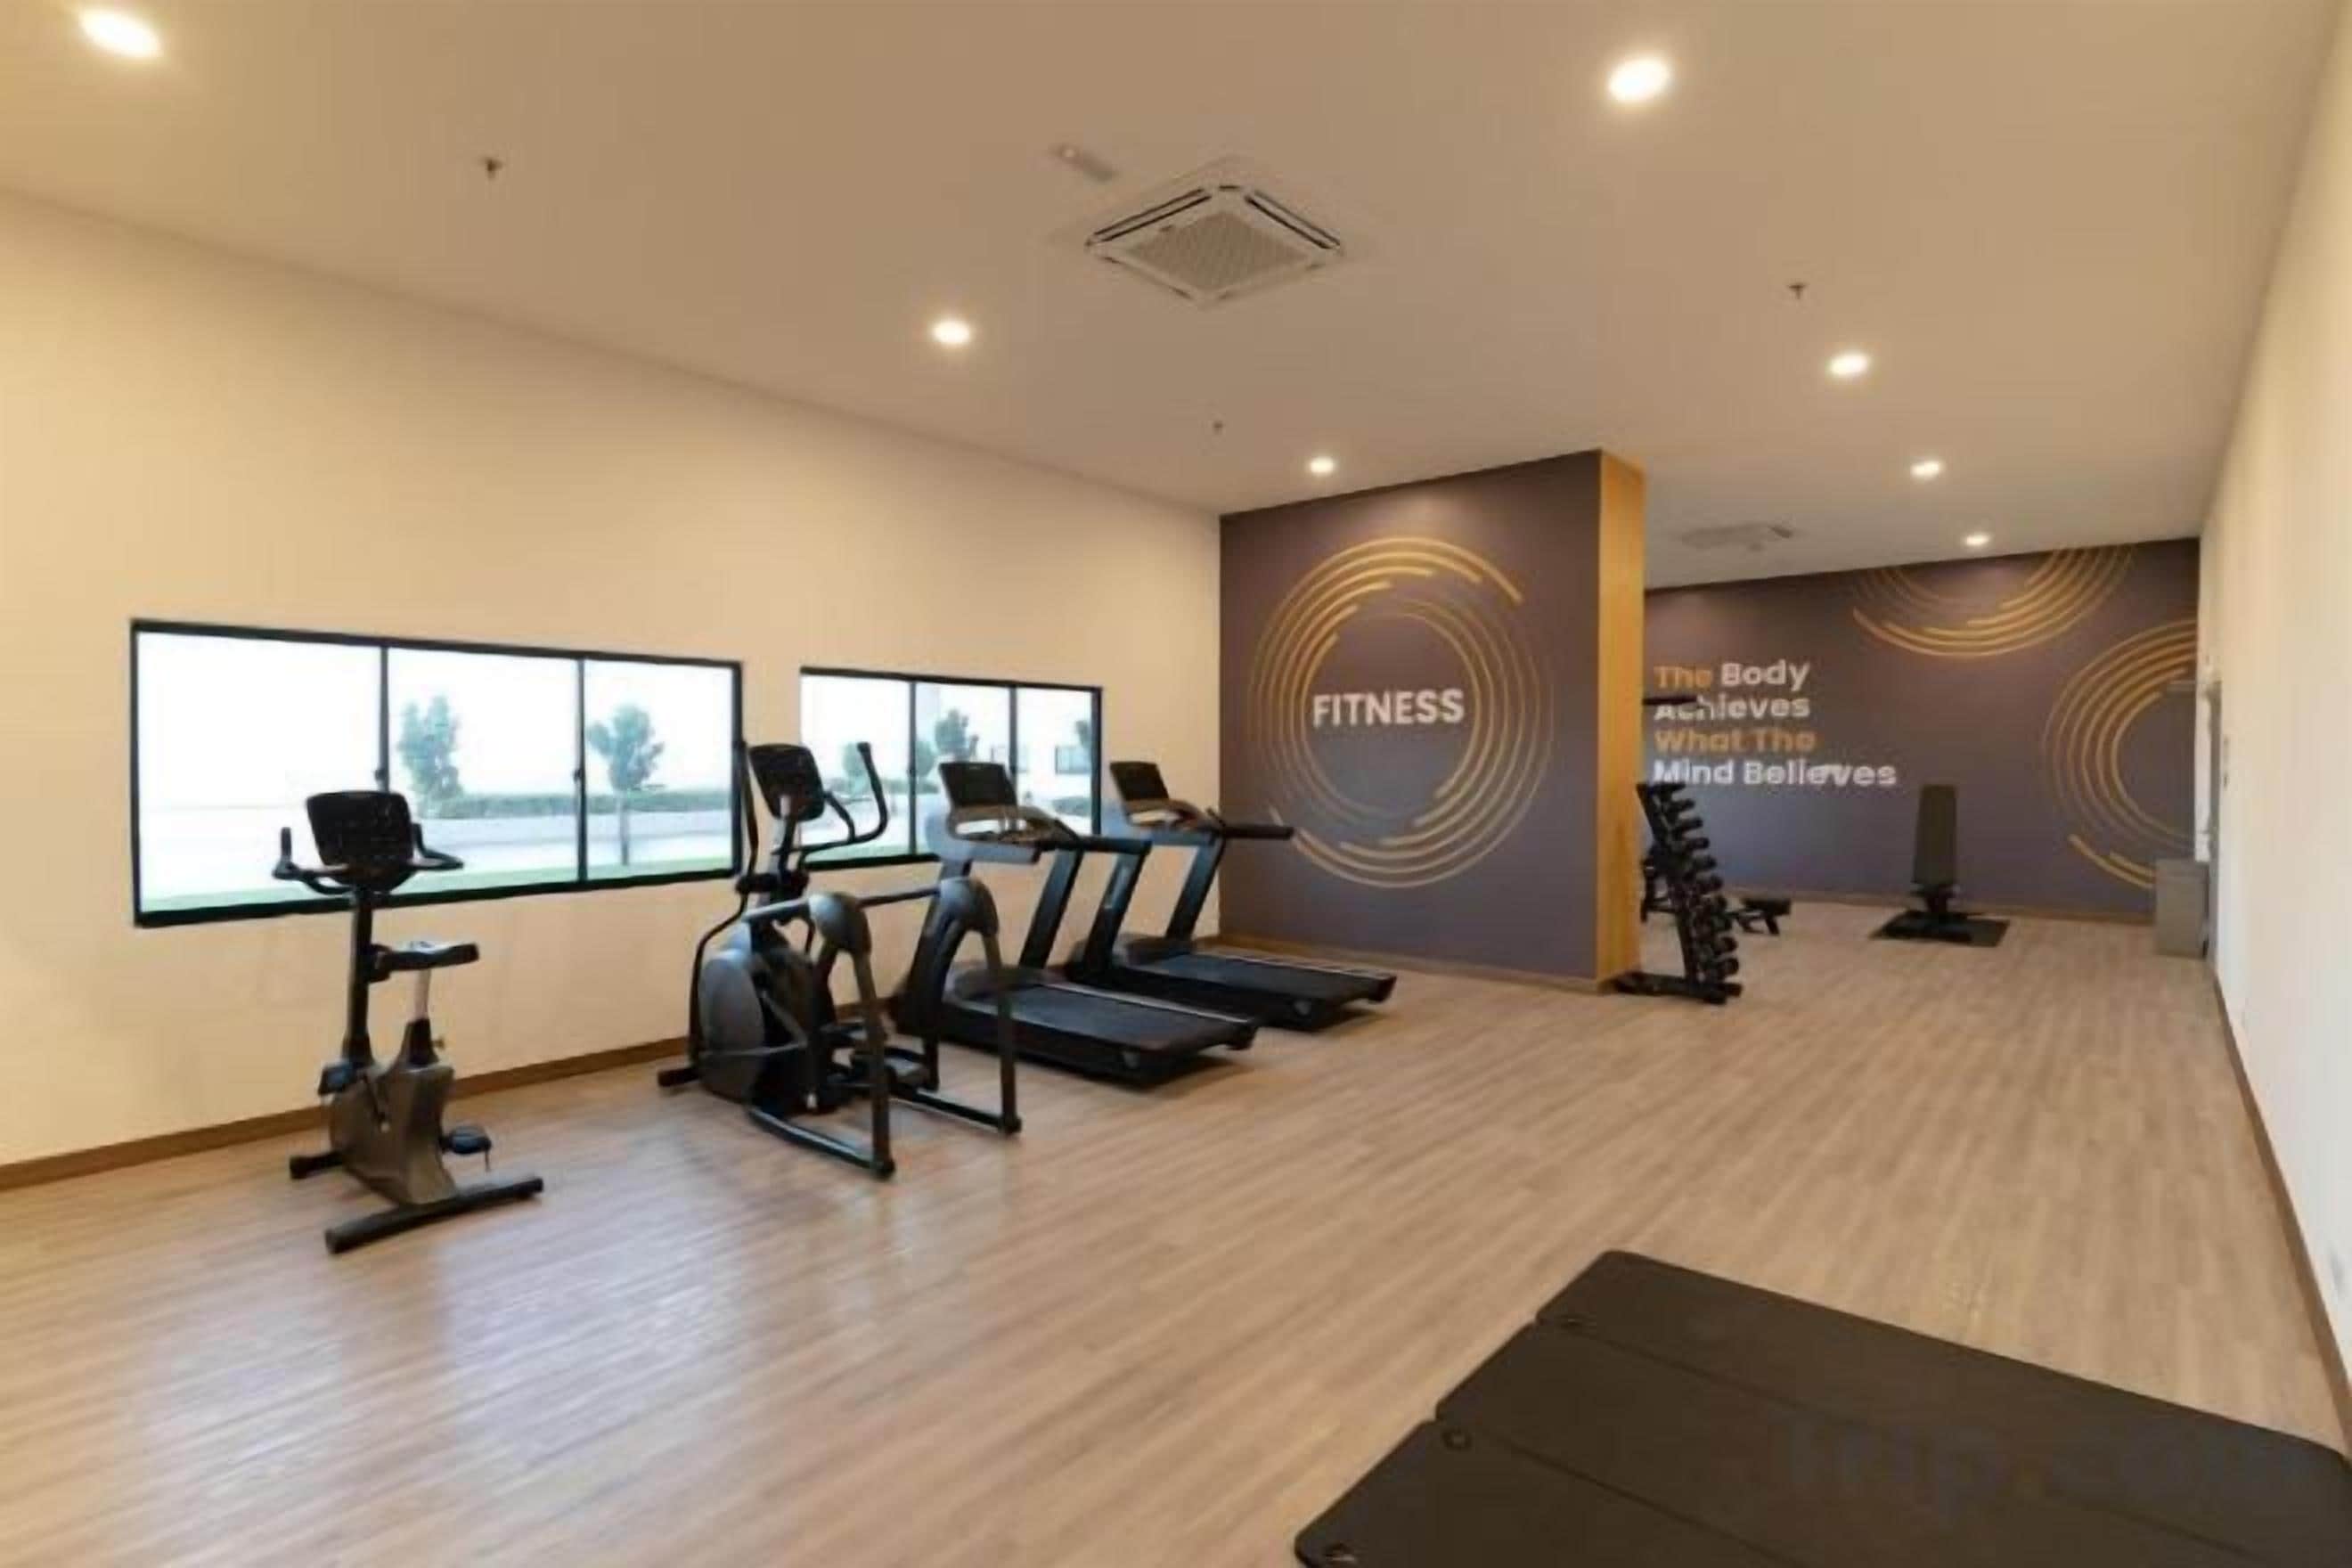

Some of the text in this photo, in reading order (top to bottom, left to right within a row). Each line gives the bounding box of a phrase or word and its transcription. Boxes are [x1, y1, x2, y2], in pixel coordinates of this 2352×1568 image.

[1654, 659, 1810, 692] The Body
[1313, 688, 1465, 727] FITNESS
[1654, 693, 1810, 721] Achieves
[1654, 729, 1816, 753] What The
[1653, 758, 1899, 786] Mind Believes
